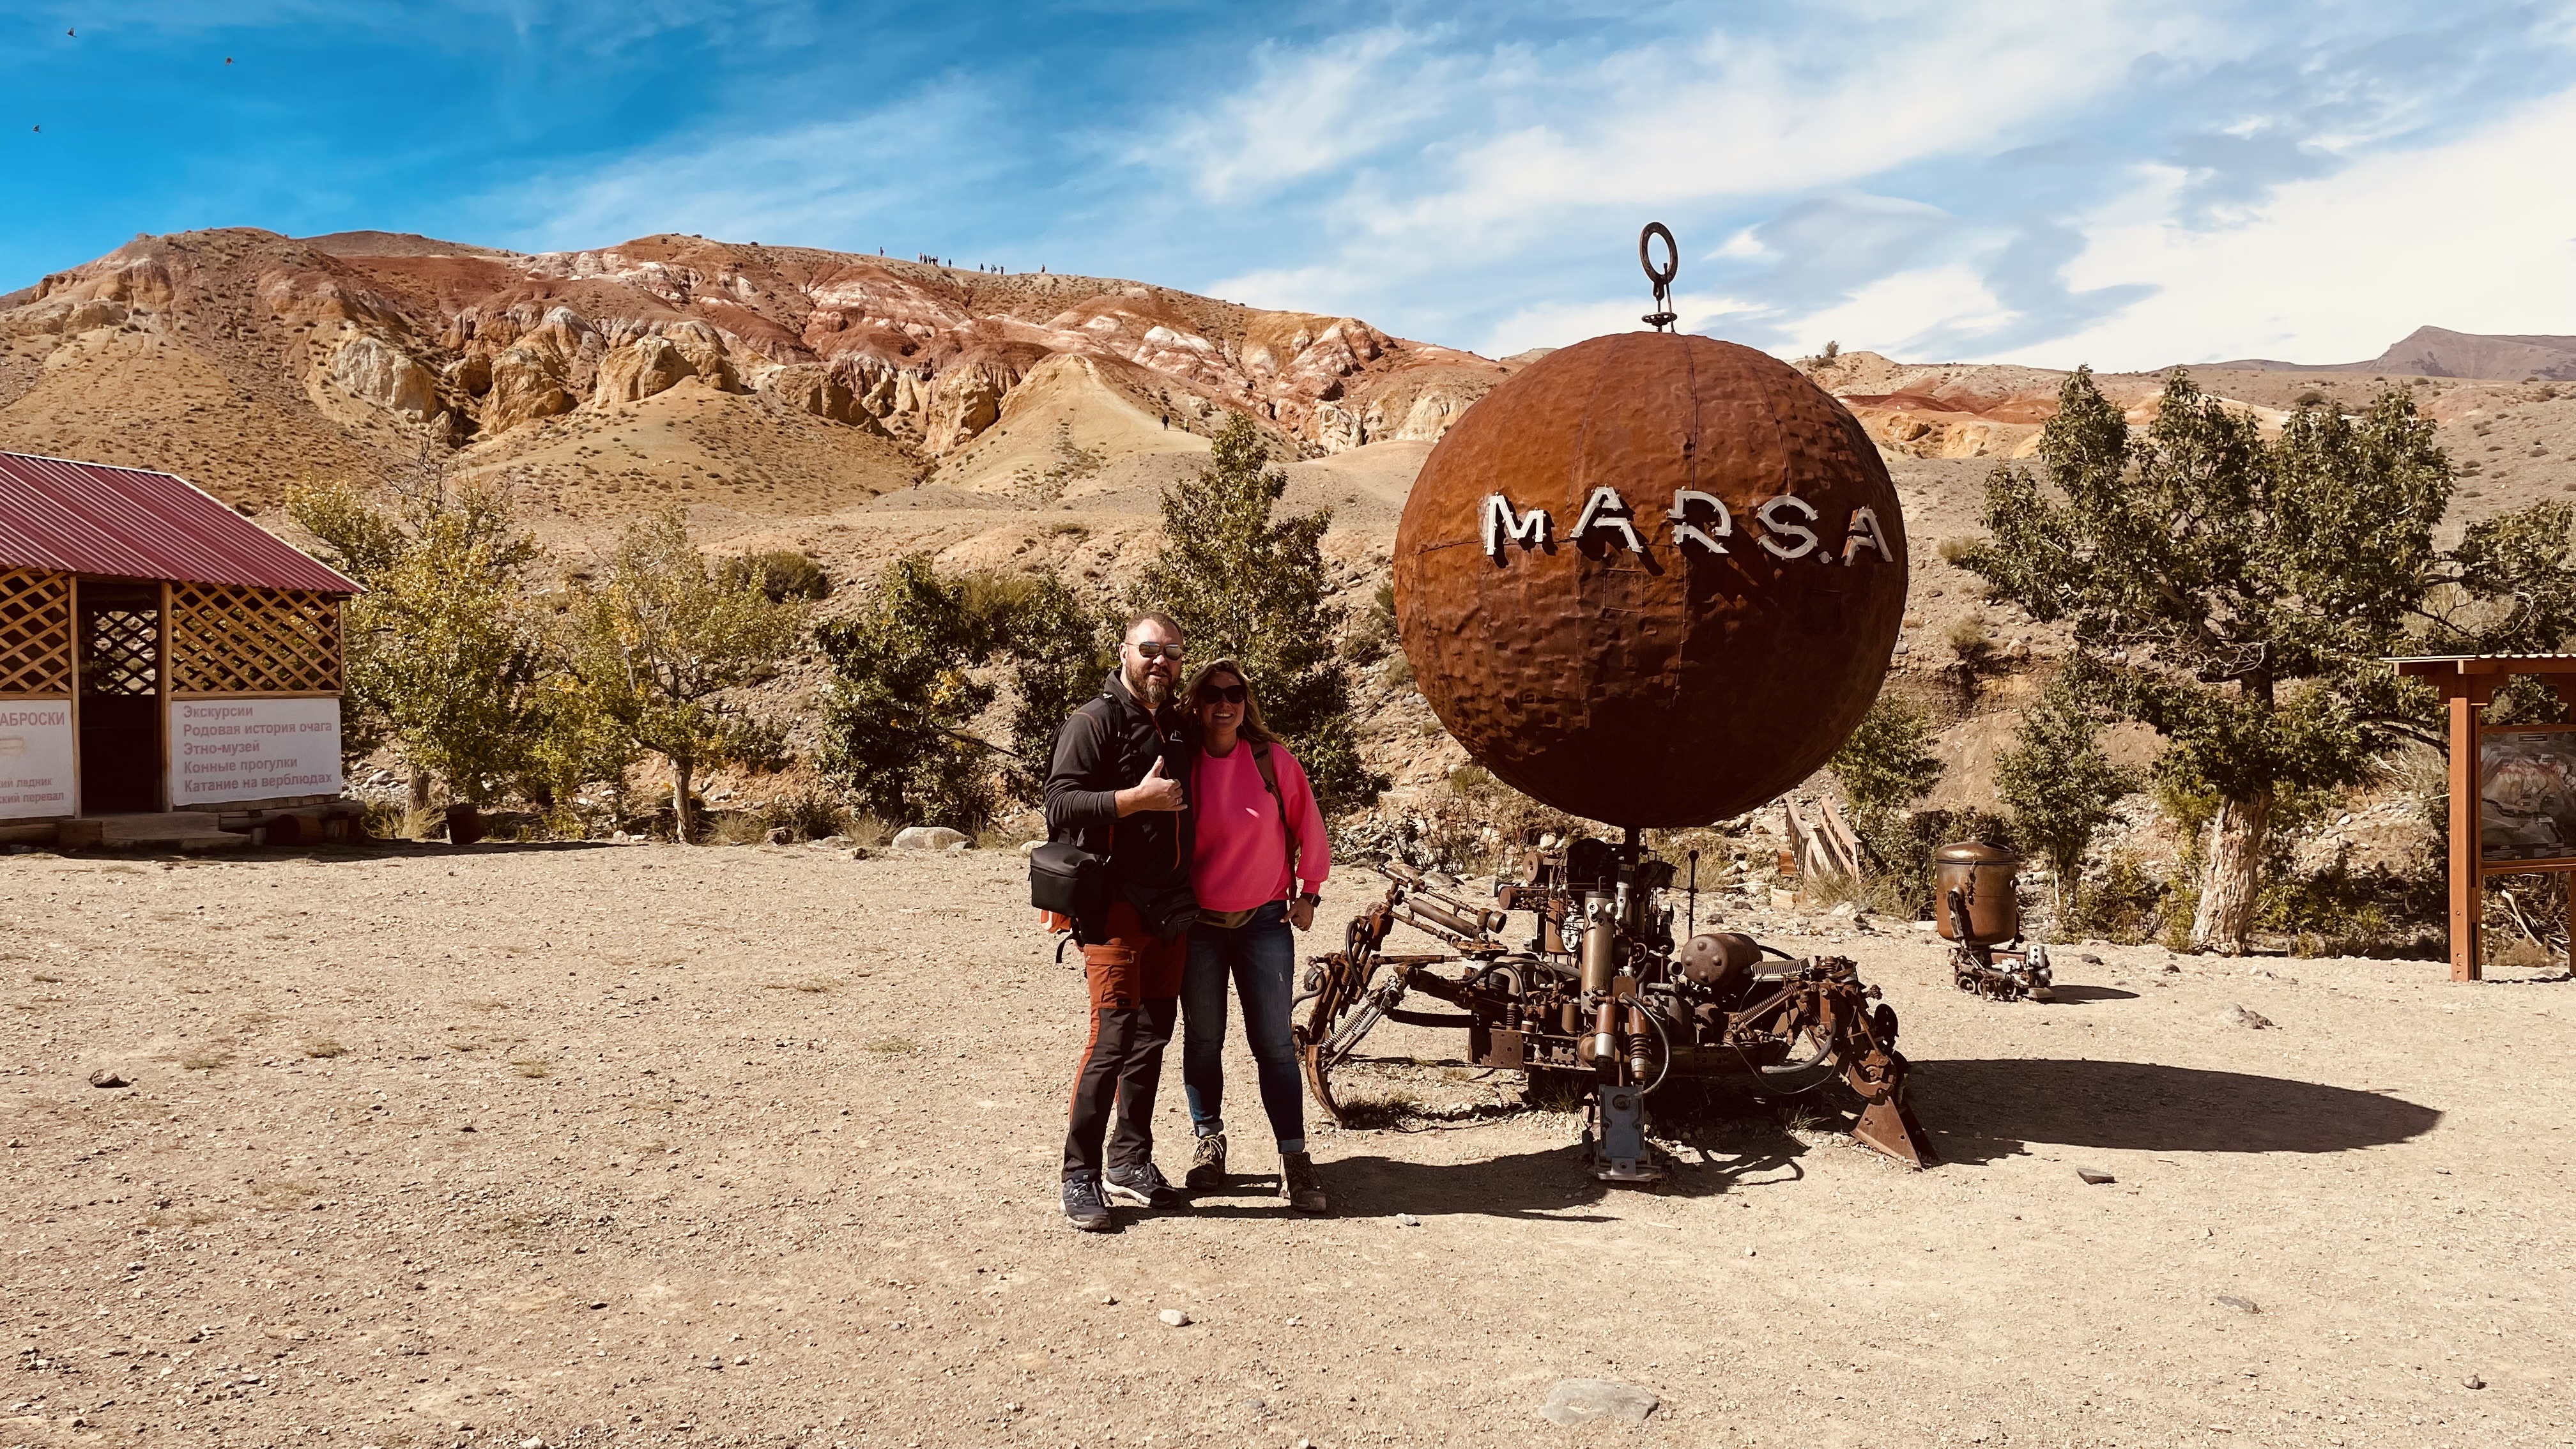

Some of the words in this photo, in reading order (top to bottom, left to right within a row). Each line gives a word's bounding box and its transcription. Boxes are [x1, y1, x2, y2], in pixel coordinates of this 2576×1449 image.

[183, 705, 253, 719] Экскурсии
[183, 723, 241, 738] Родовая
[245, 723, 296, 735] история
[300, 722, 332, 732] очага
[183, 740, 260, 756] Этно-музей
[184, 761, 236, 774] Конные
[240, 758, 298, 772] прогулки
[16, 778, 52, 789] ледник
[185, 779, 239, 793] Катание
[243, 778, 257, 788] на
[261, 774, 332, 788] верблюдах
[23, 792, 65, 804] перевал
